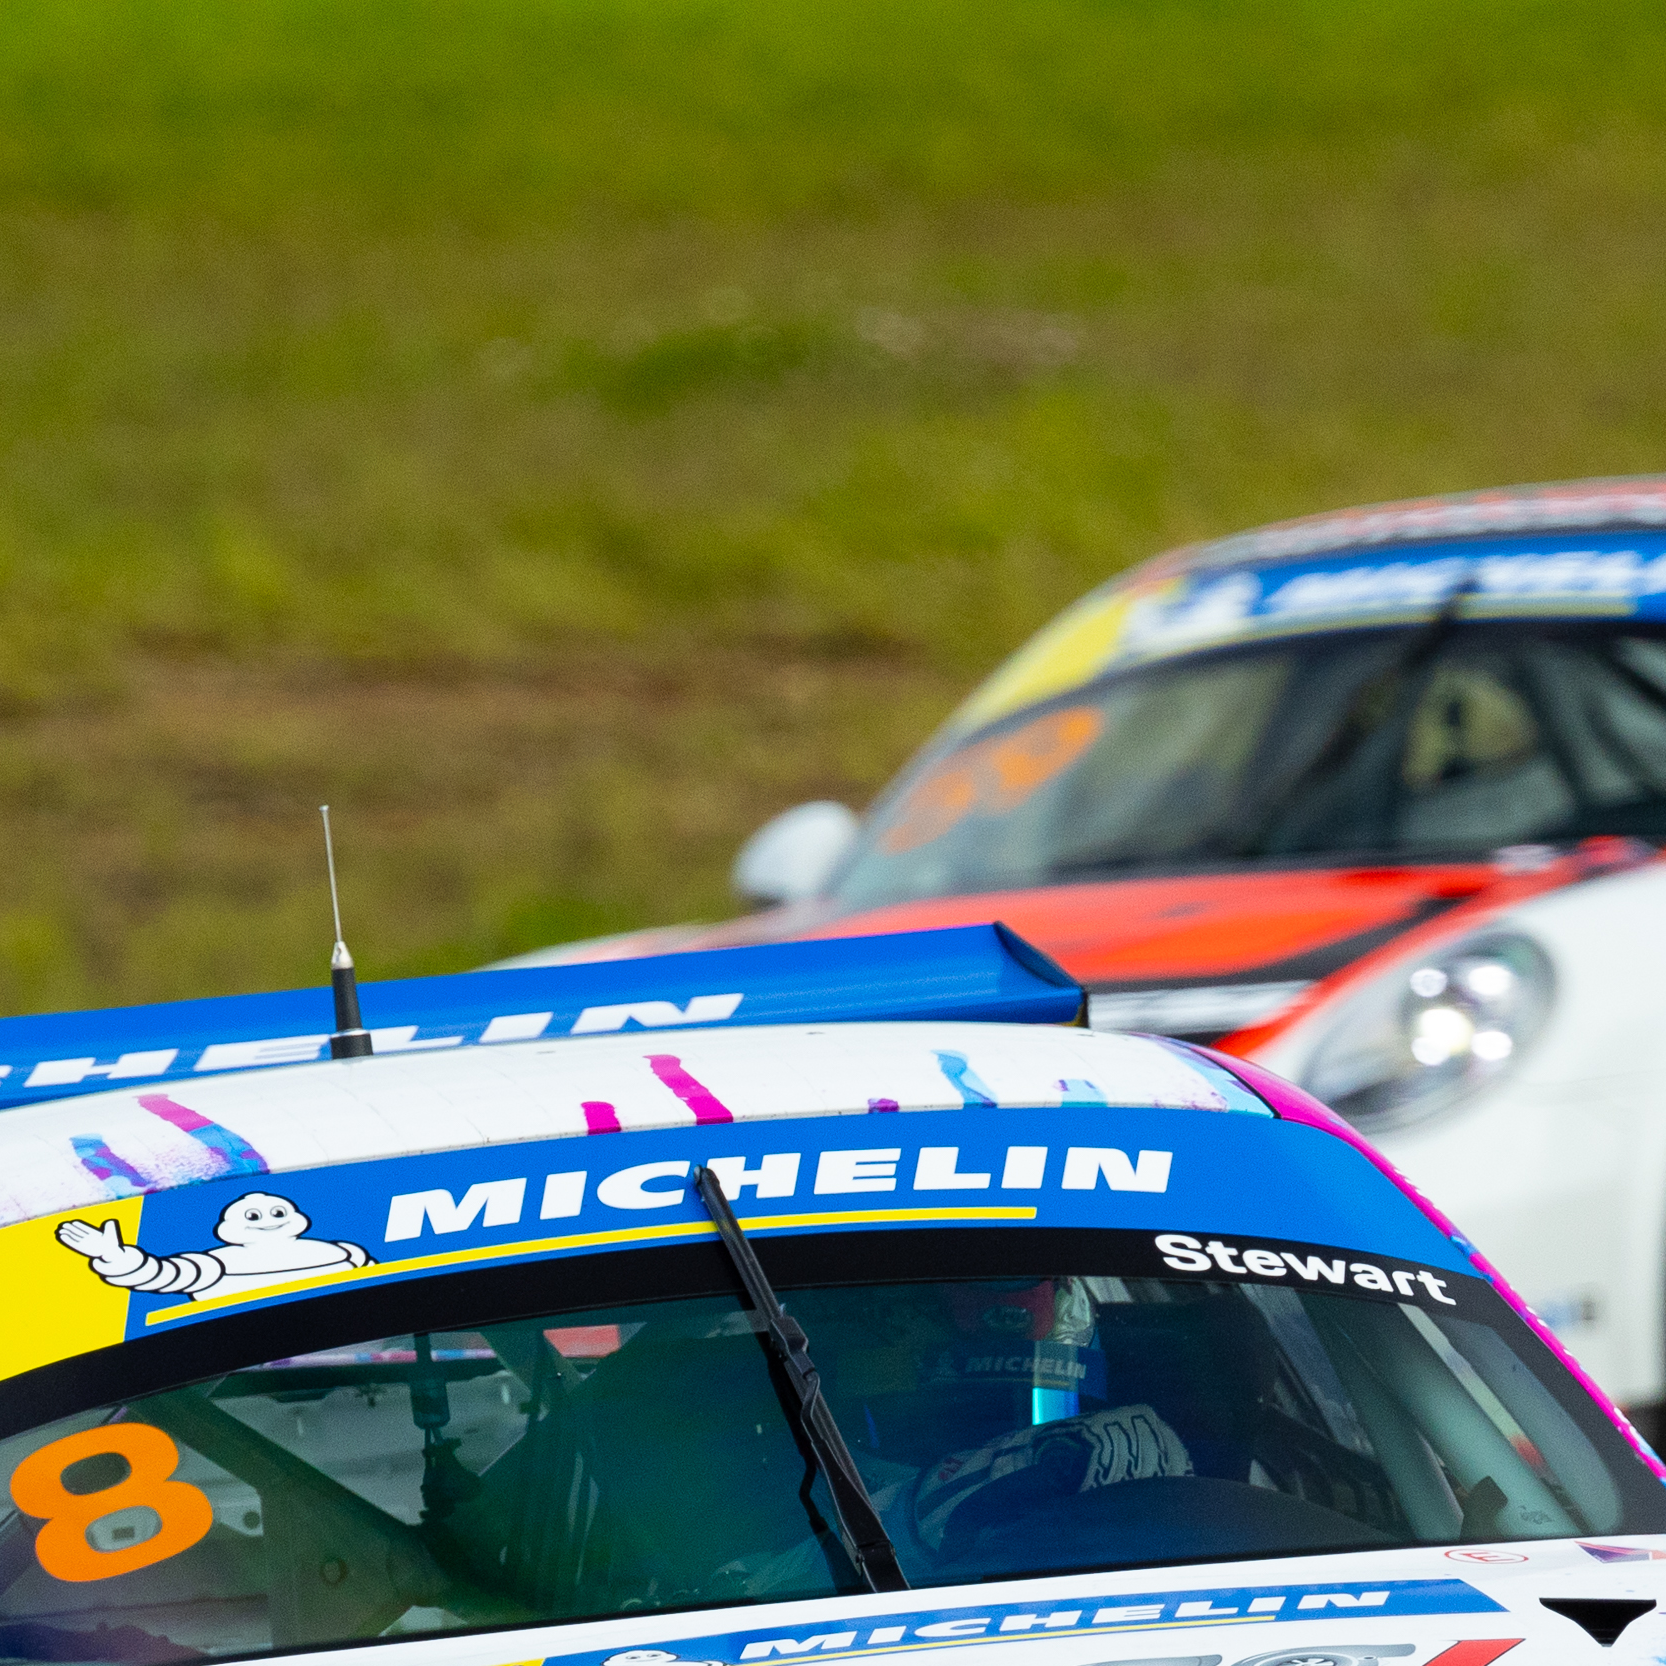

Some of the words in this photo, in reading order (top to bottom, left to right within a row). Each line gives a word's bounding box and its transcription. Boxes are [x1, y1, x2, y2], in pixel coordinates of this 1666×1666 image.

[384, 1146, 1173, 1243] MICHELIN
[1153, 1233, 1457, 1306] Stewart
[965, 1354, 1087, 1380] MICHELIN
[9, 1422, 214, 1583] 8
[738, 1590, 1393, 1662] MICHELIN
